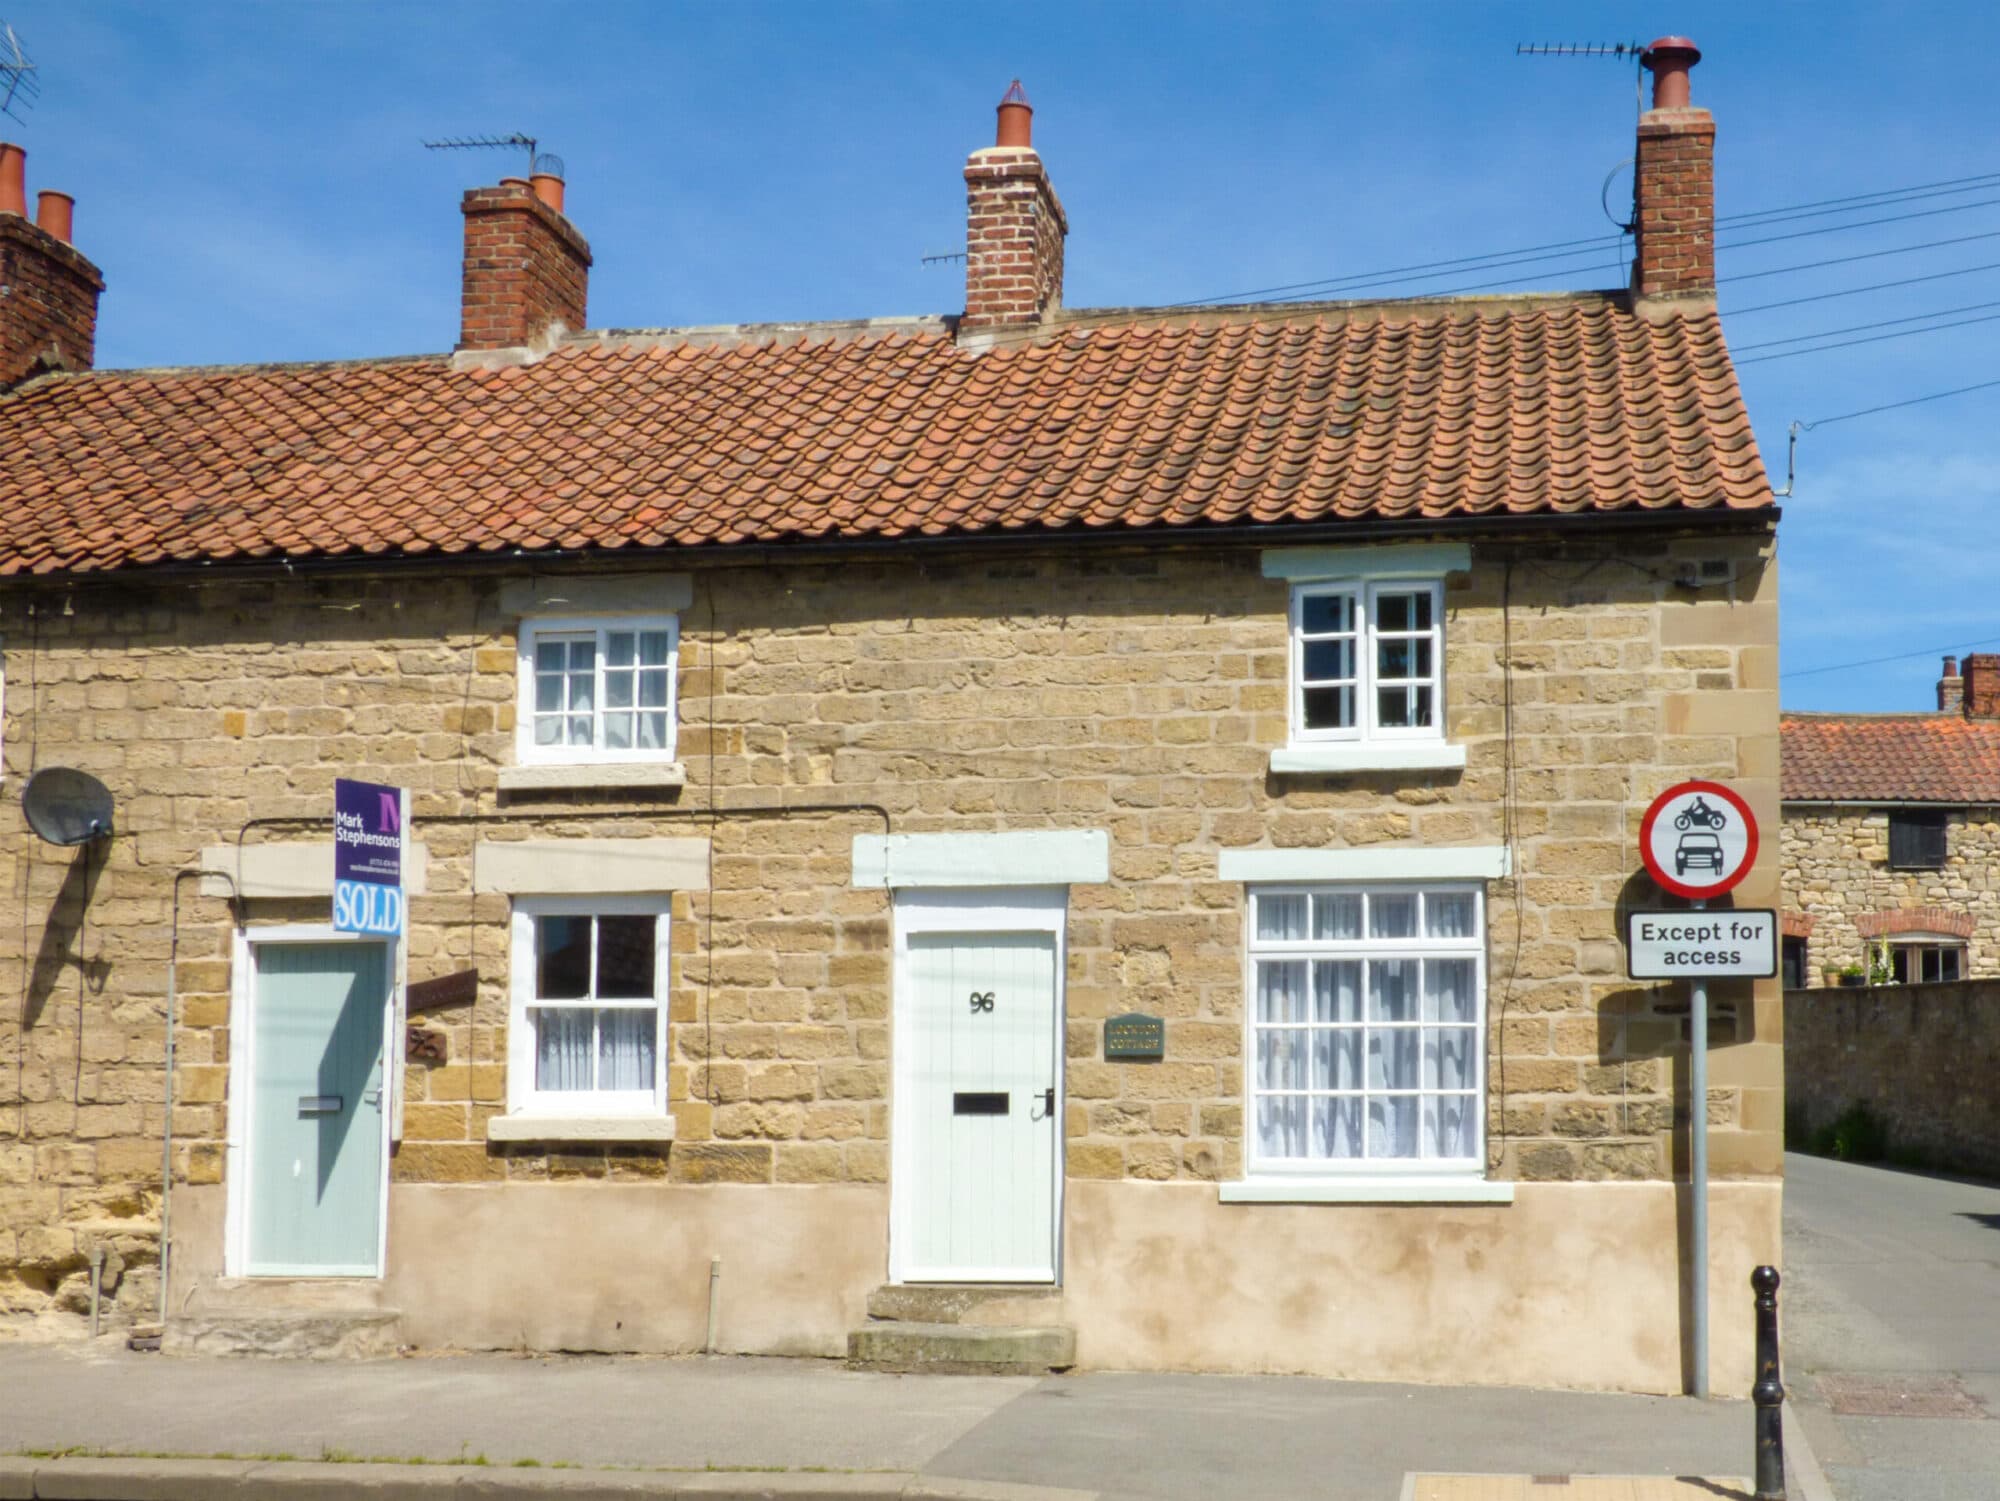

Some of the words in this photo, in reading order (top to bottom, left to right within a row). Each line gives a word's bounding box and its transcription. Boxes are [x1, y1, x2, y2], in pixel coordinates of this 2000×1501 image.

[336, 811, 363, 829] Mark
[336, 826, 401, 849] Stephensons
[336, 881, 401, 932] SOLD
[1641, 923, 1722, 943] Except
[1729, 922, 1764, 941] for
[1663, 950, 1742, 966] access
[969, 991, 996, 1015] 96
[1109, 1039, 1160, 1049] COTTAGE
